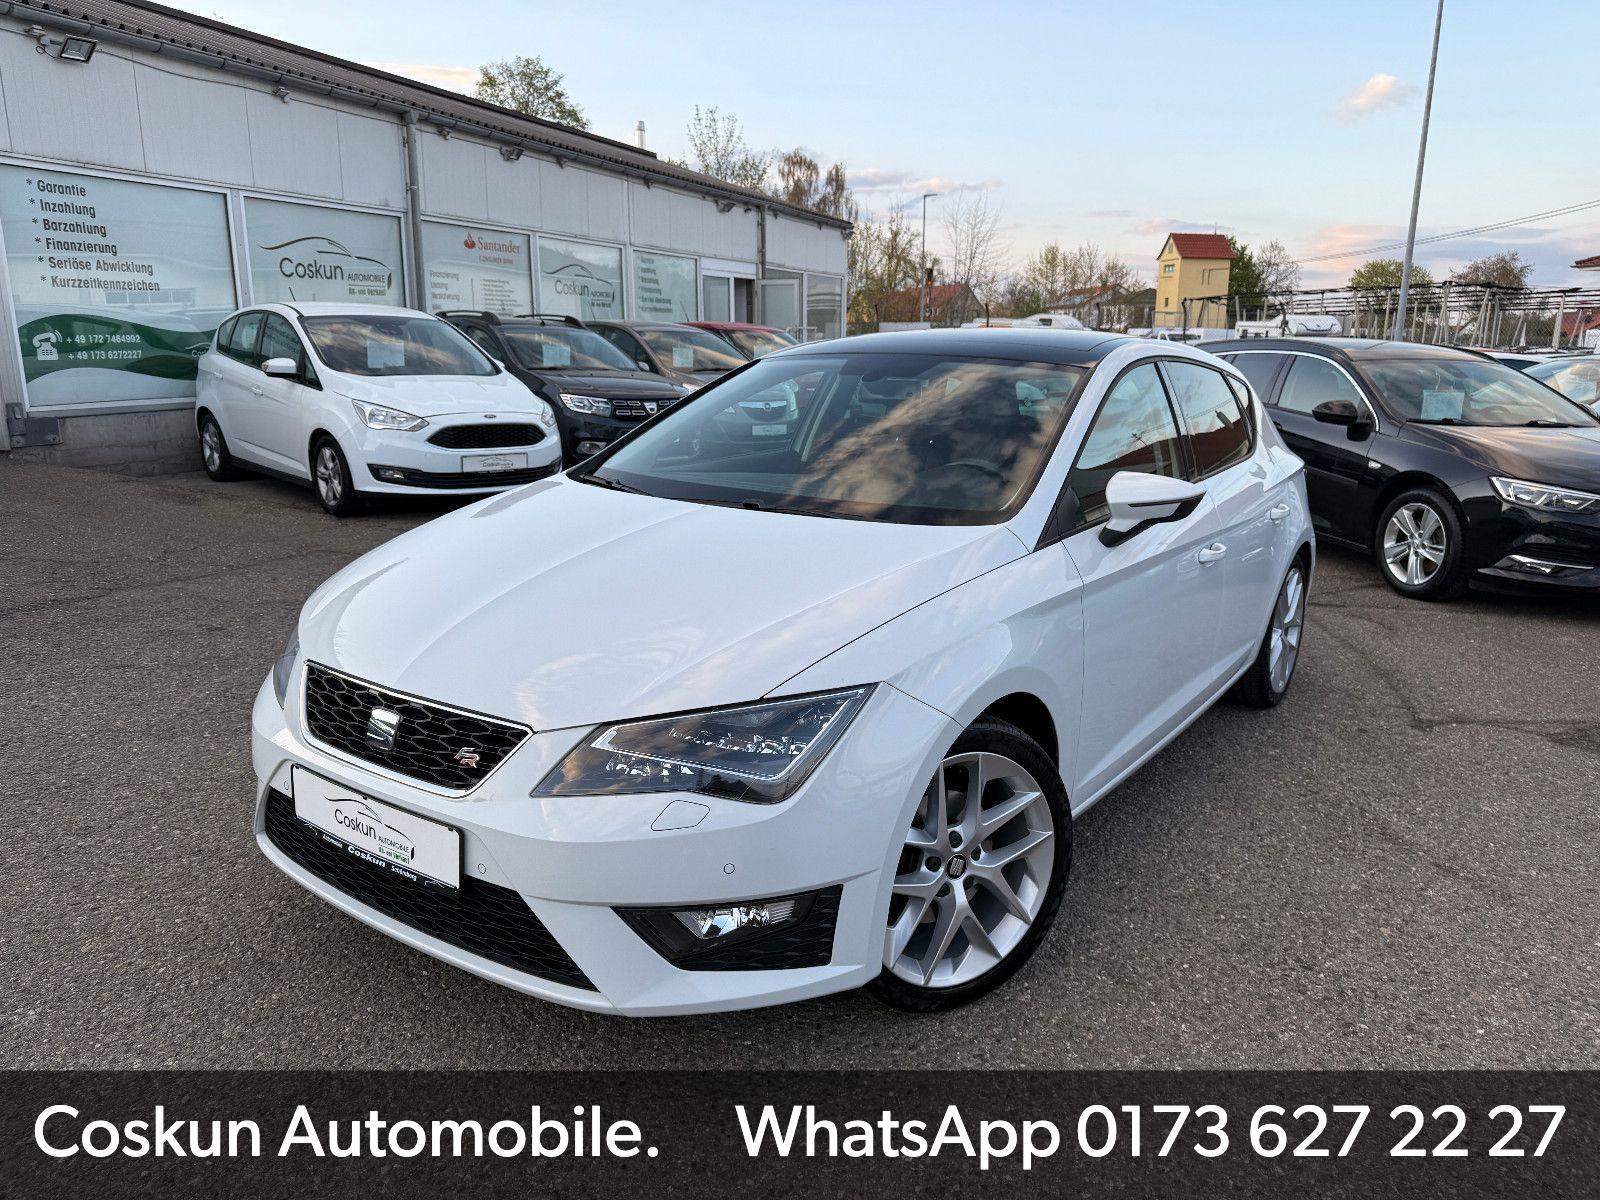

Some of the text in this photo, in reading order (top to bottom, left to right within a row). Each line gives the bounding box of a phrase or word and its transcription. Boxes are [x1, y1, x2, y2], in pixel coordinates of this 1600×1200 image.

[37, 180, 87, 197] Garantie
[40, 199, 96, 218] Inzahlung
[43, 218, 107, 238] Barzahlung
[45, 237, 118, 257] Finanzierung
[477, 236, 520, 254] Santander
[48, 256, 154, 276] Seriöse Abwicklung
[279, 257, 344, 281] Coskun
[51, 275, 160, 292] Kurzzeitkennzeichen
[347, 272, 386, 283] AUTOMOBILE
[555, 279, 590, 297] Coskun
[88, 334, 104, 344] 172
[106, 334, 141, 343] 7464992
[90, 351, 106, 360] 173
[108, 350, 142, 359] 6272227
[334, 808, 377, 839] Coskun
[378, 835, 409, 852] AUTOMOBILE
[347, 845, 386, 868] Coskun
